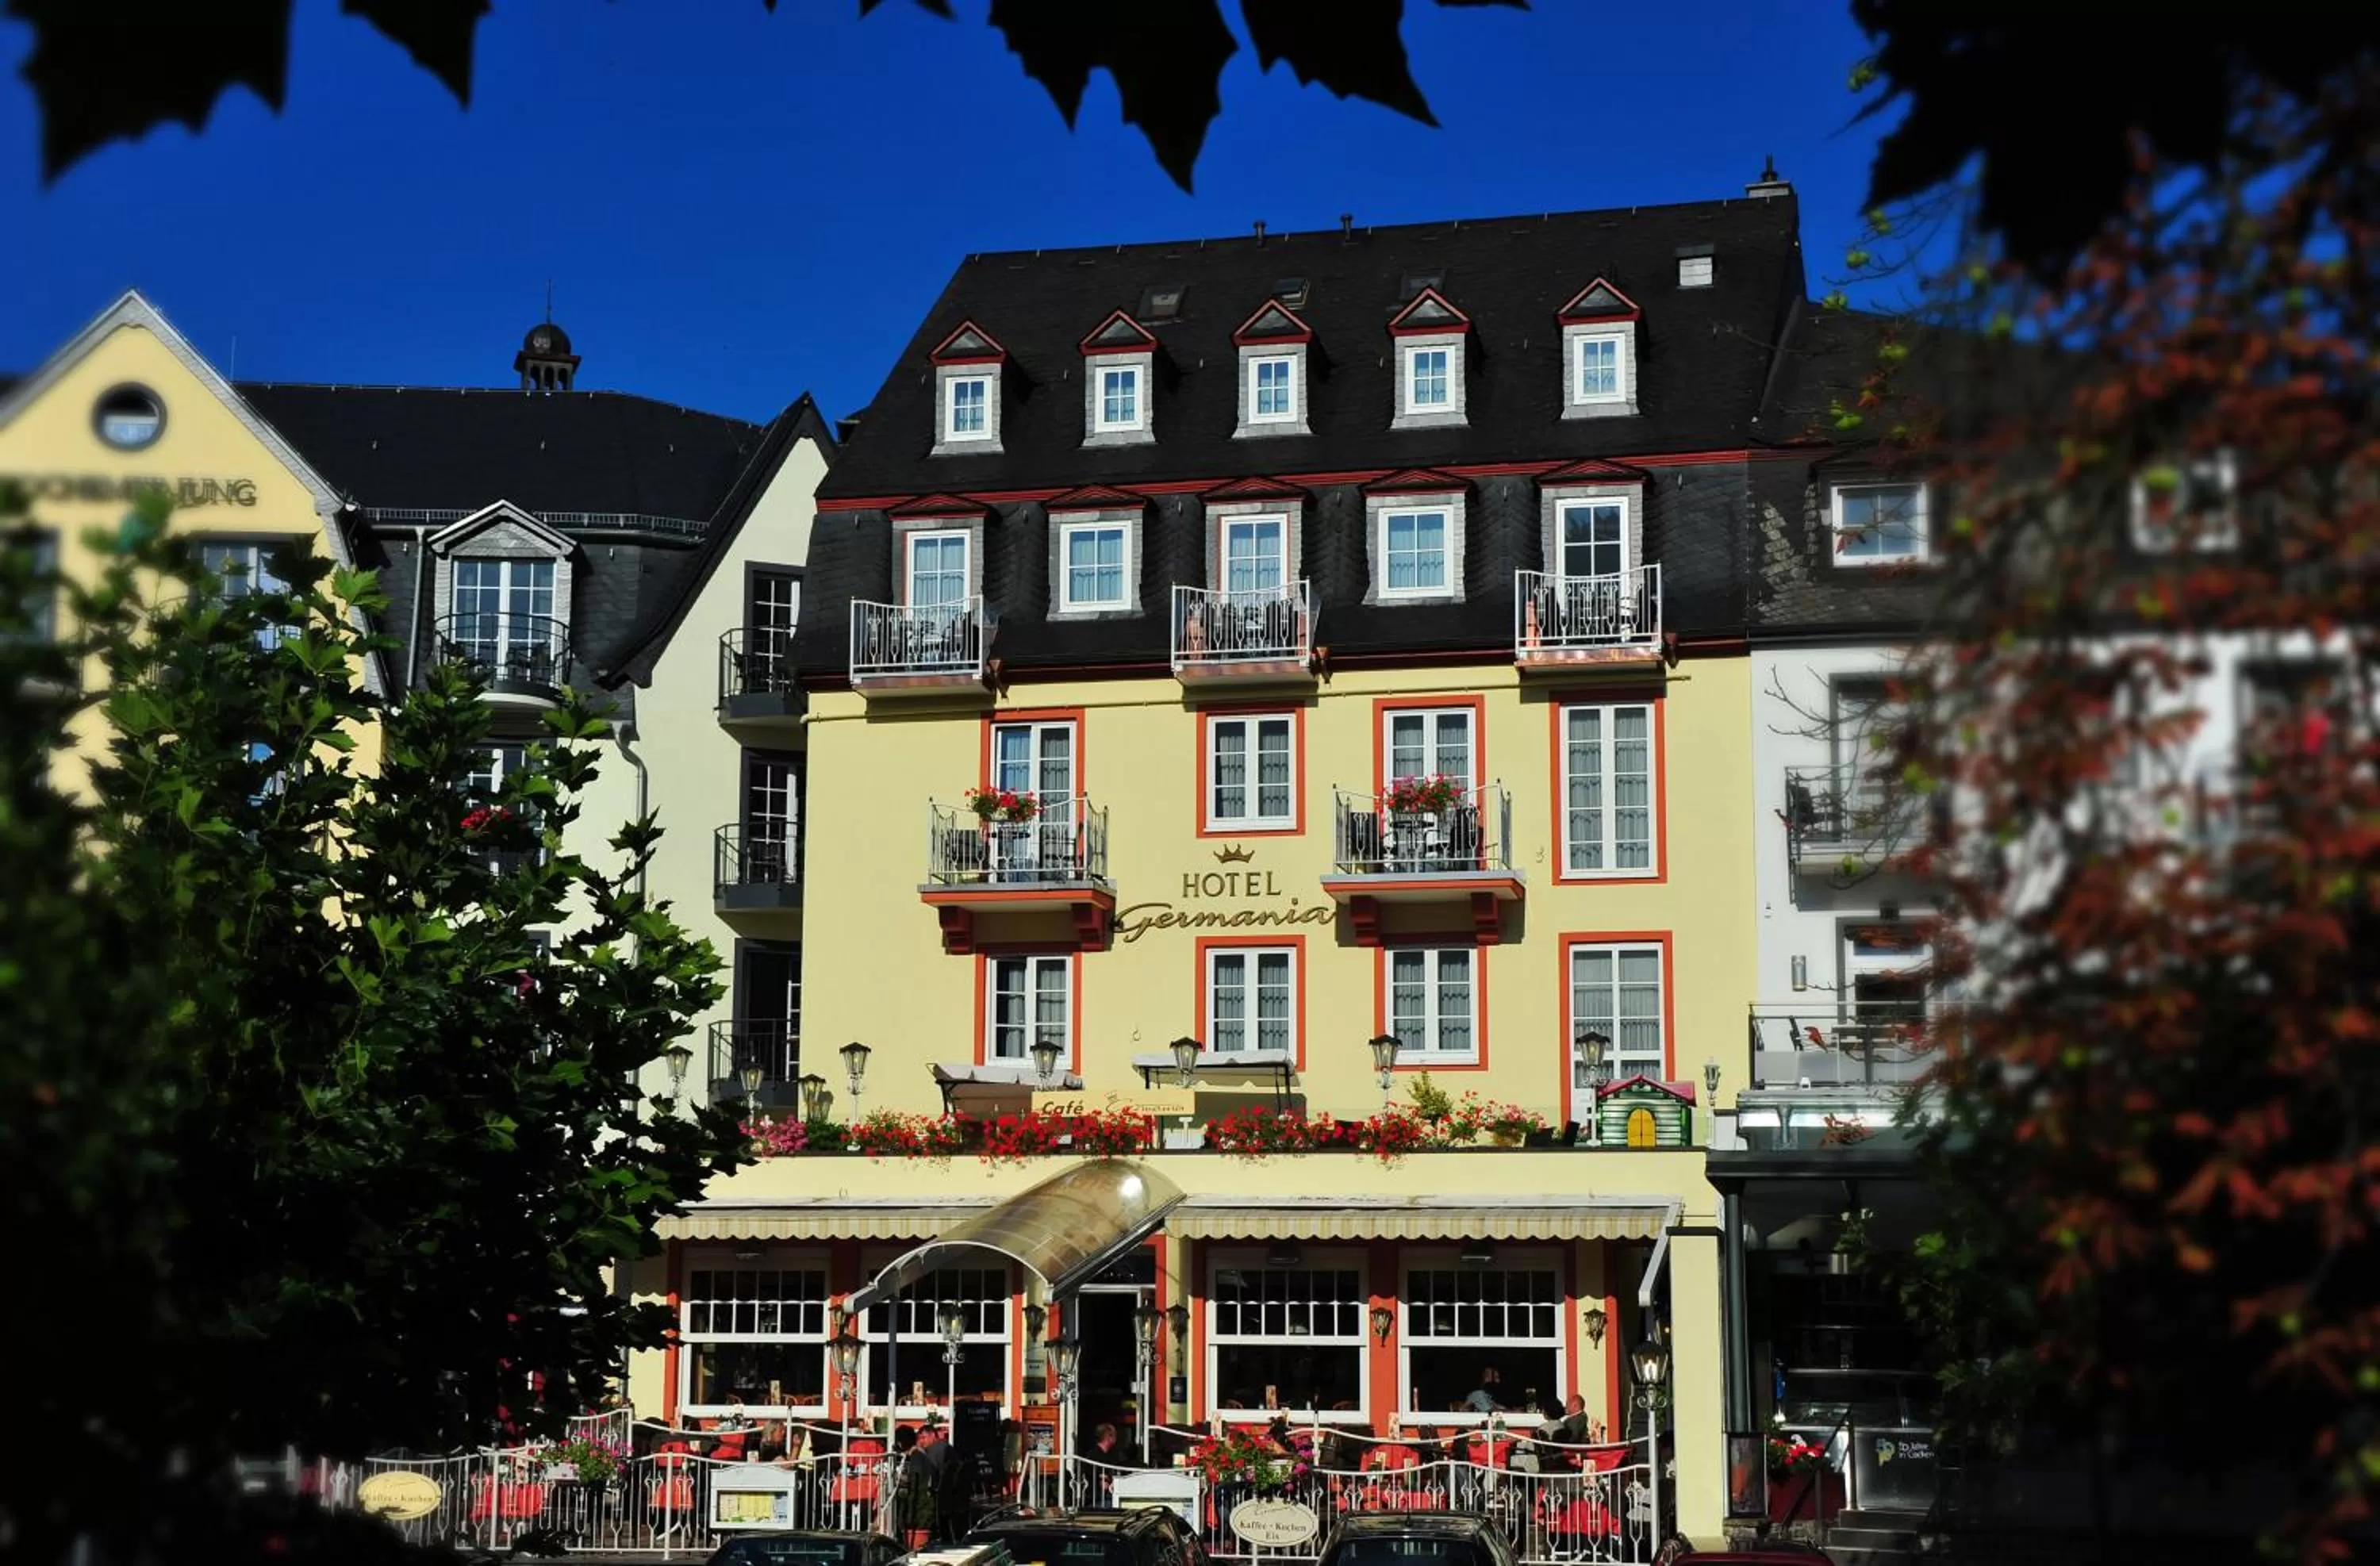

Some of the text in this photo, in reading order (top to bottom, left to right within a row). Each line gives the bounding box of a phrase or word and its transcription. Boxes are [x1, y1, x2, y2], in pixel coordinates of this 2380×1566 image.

[1182, 871, 1282, 898] HOTEL
[1112, 898, 1337, 943] Germania
[1042, 1100, 1084, 1115] Café
